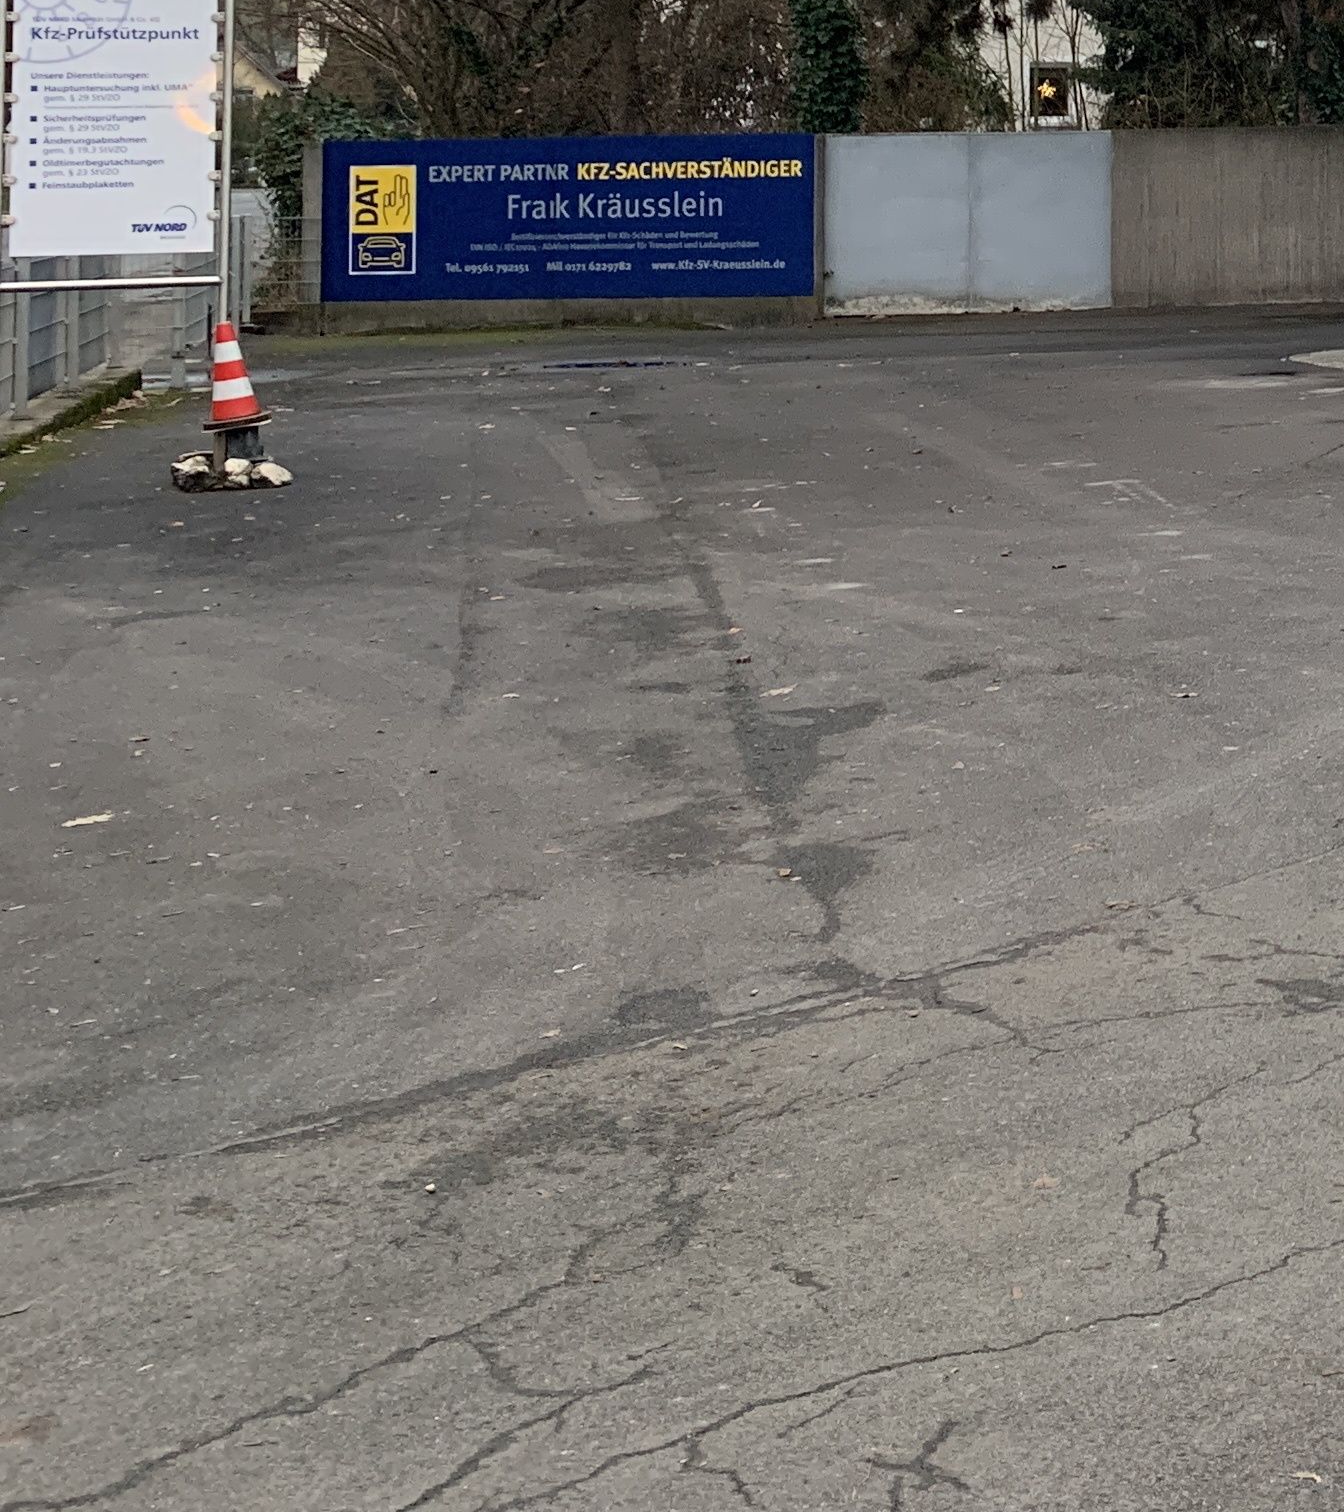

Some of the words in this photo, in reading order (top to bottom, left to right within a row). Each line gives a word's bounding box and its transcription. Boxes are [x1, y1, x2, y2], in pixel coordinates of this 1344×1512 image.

[31, 26, 200, 43] Kfz-Prüfstützpunkt
[30, 72, 64, 80] Unsere
[43, 84, 140, 94] Hauptuntersuchung
[43, 113, 147, 124] Sicherheitsprüfungen
[42, 136, 147, 146] Änderungsabnahmen
[42, 158, 165, 168] Oldtimerbegutachtungen
[428, 164, 496, 183] EXPERT
[576, 157, 803, 181] KFZ-SACHVERSTÄNDIGER
[41, 180, 135, 190] Feinstaubplaketten
[354, 174, 380, 228] DAT
[578, 190, 724, 219] Kräusslein
[131, 222, 153, 233] TÜV
[154, 222, 188, 233] NORD
[445, 262, 462, 273] Tel.
[464, 263, 494, 275] 09561
[495, 262, 530, 275] 792151
[564, 263, 586, 273] 0171
[651, 258, 786, 270] www.Kfz-SV-Kraeusslein.de
